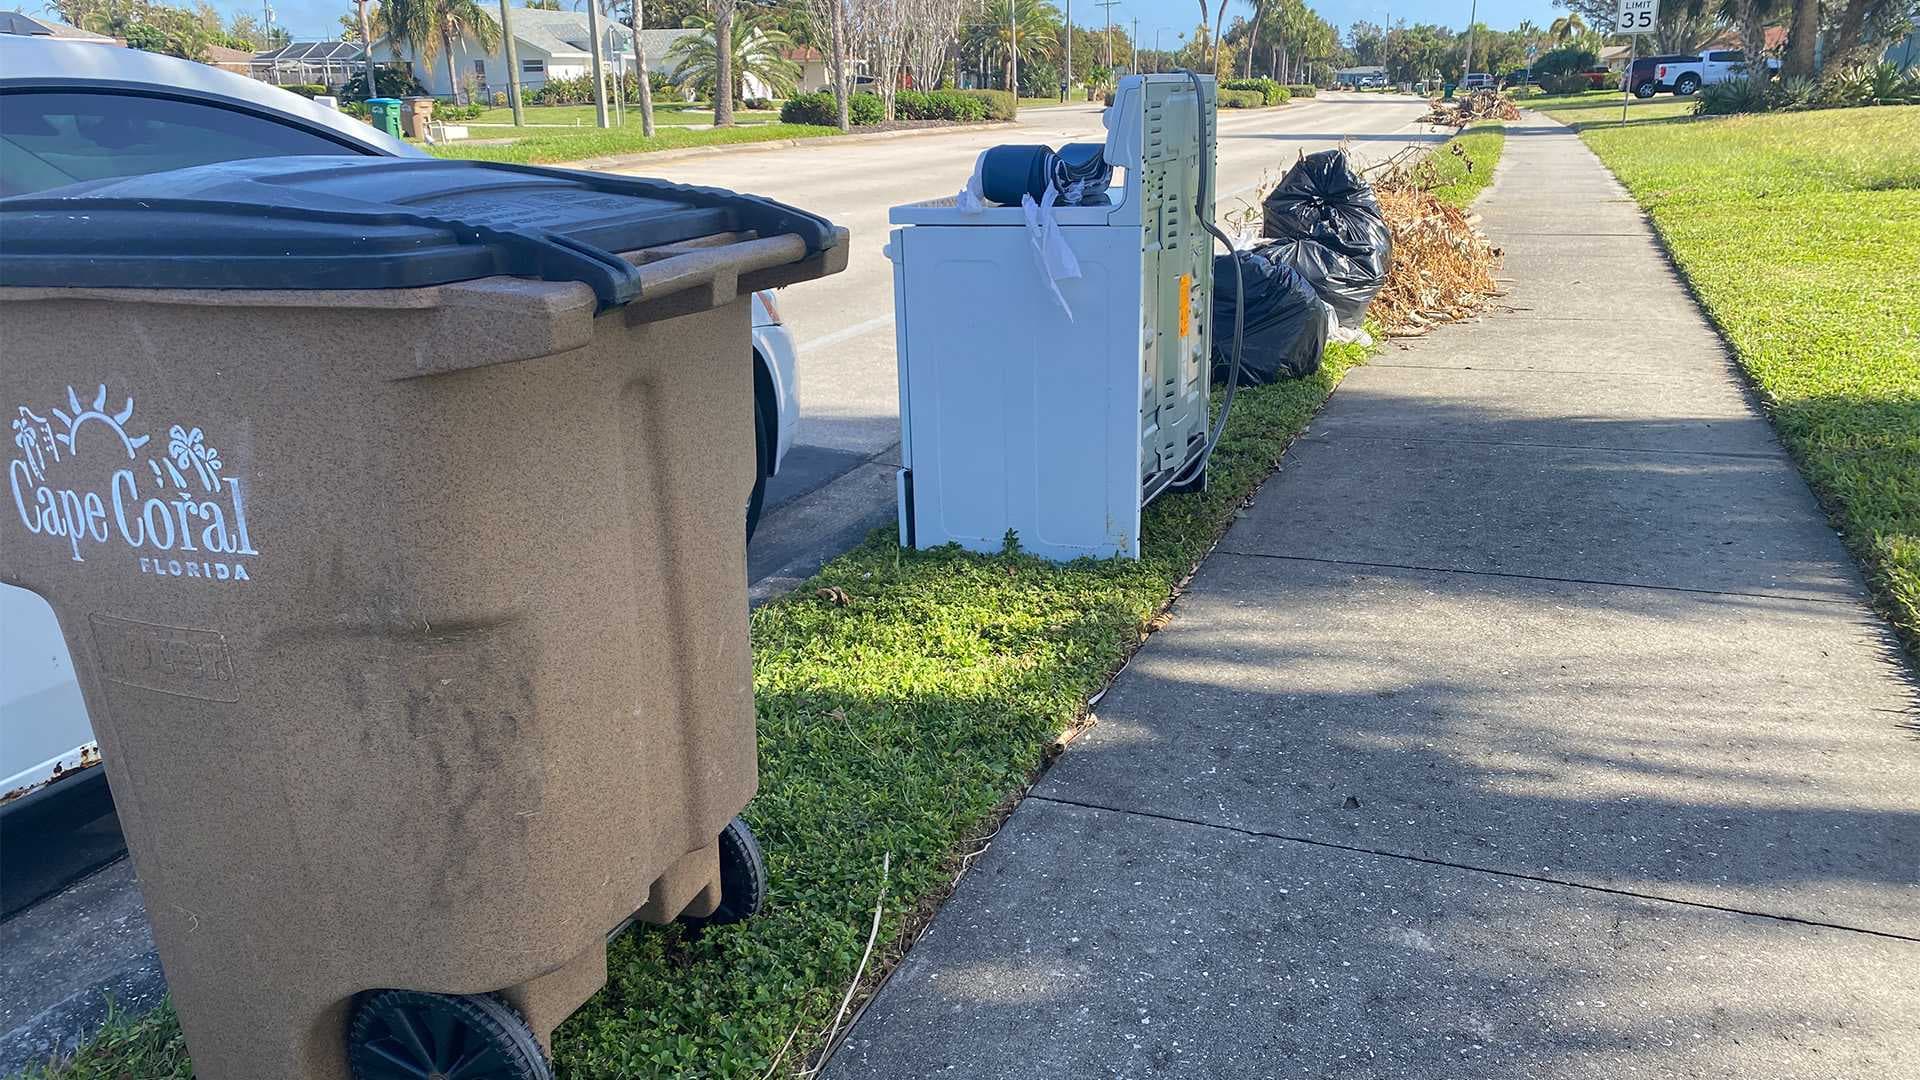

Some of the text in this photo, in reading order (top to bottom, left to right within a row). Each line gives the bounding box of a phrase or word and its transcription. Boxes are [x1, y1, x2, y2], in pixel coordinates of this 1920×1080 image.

[1625, 1, 1652, 9] LIMIT
[1621, 11, 1652, 28] 35
[10, 459, 259, 562] Cape Coral
[139, 557, 250, 581] FLORIDA
